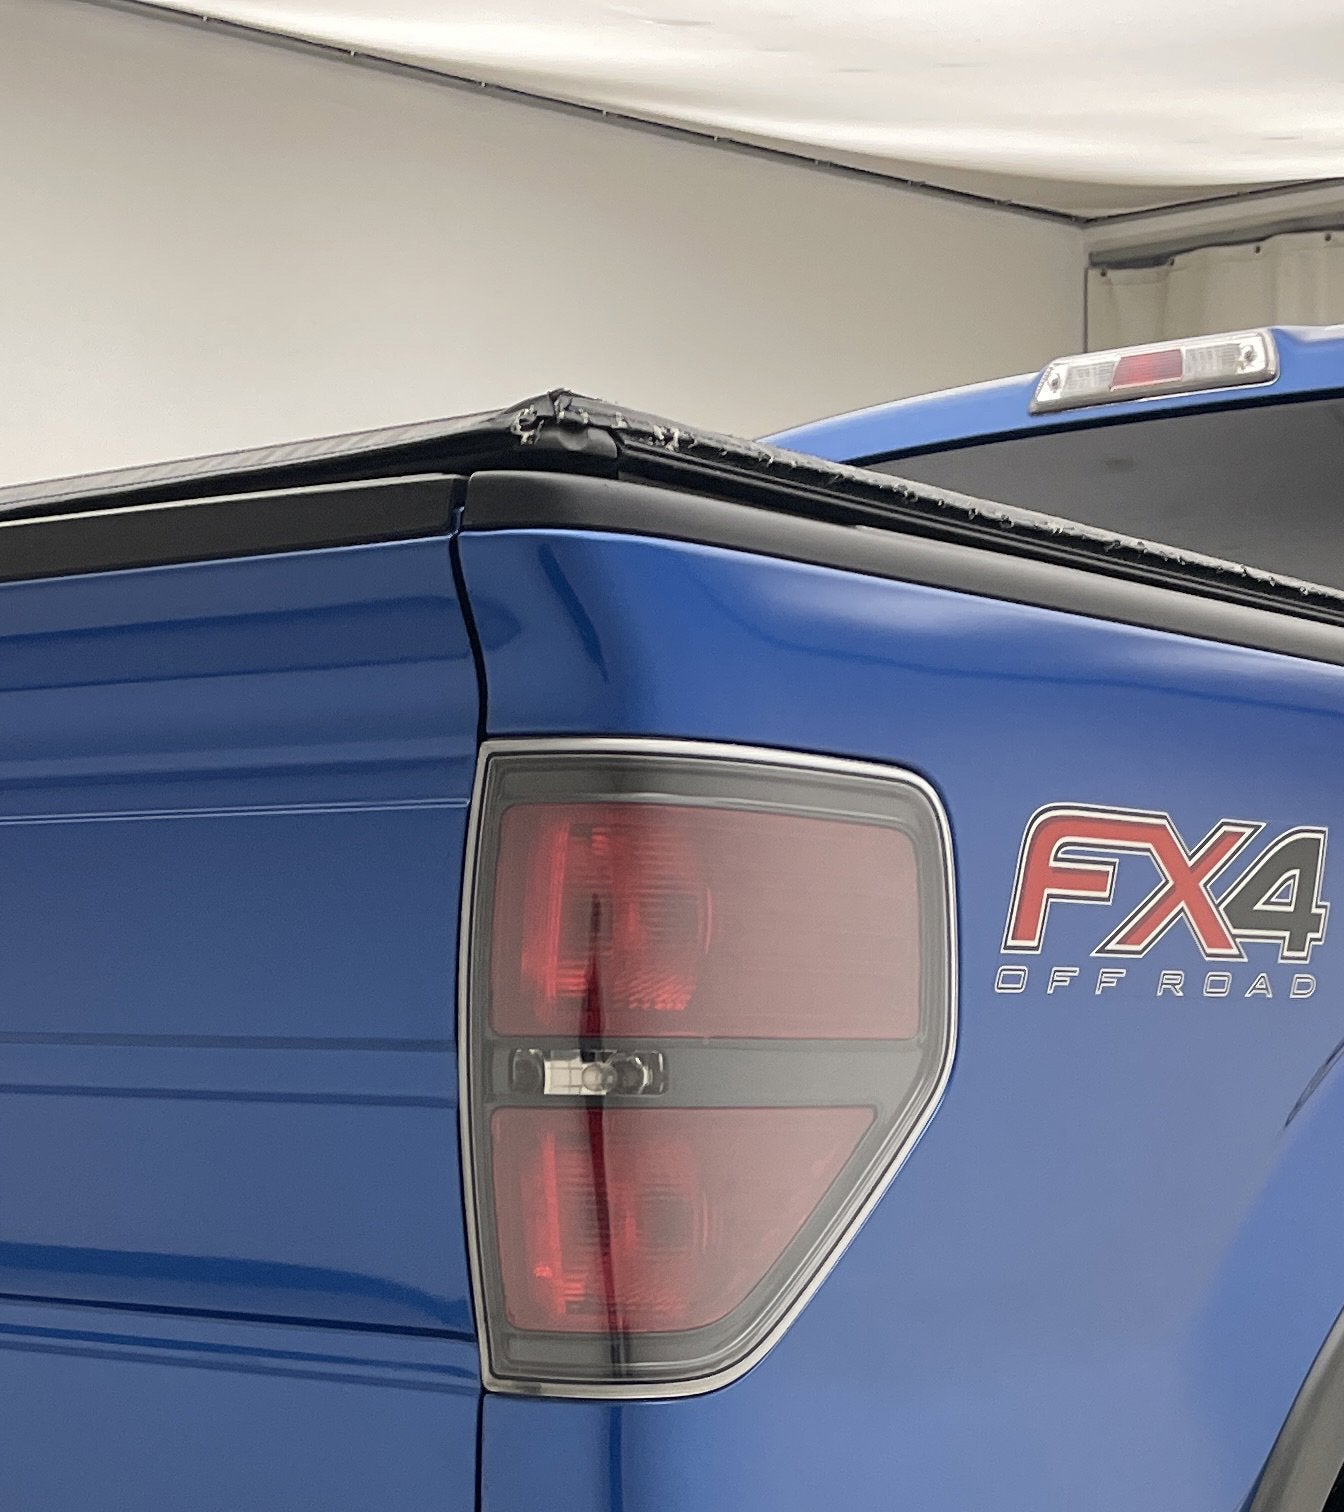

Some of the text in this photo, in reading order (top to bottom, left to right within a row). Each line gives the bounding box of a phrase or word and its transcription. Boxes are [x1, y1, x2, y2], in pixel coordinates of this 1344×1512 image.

[1000, 802, 1330, 964] FX4
[994, 965, 1317, 999] OFF ROAD
